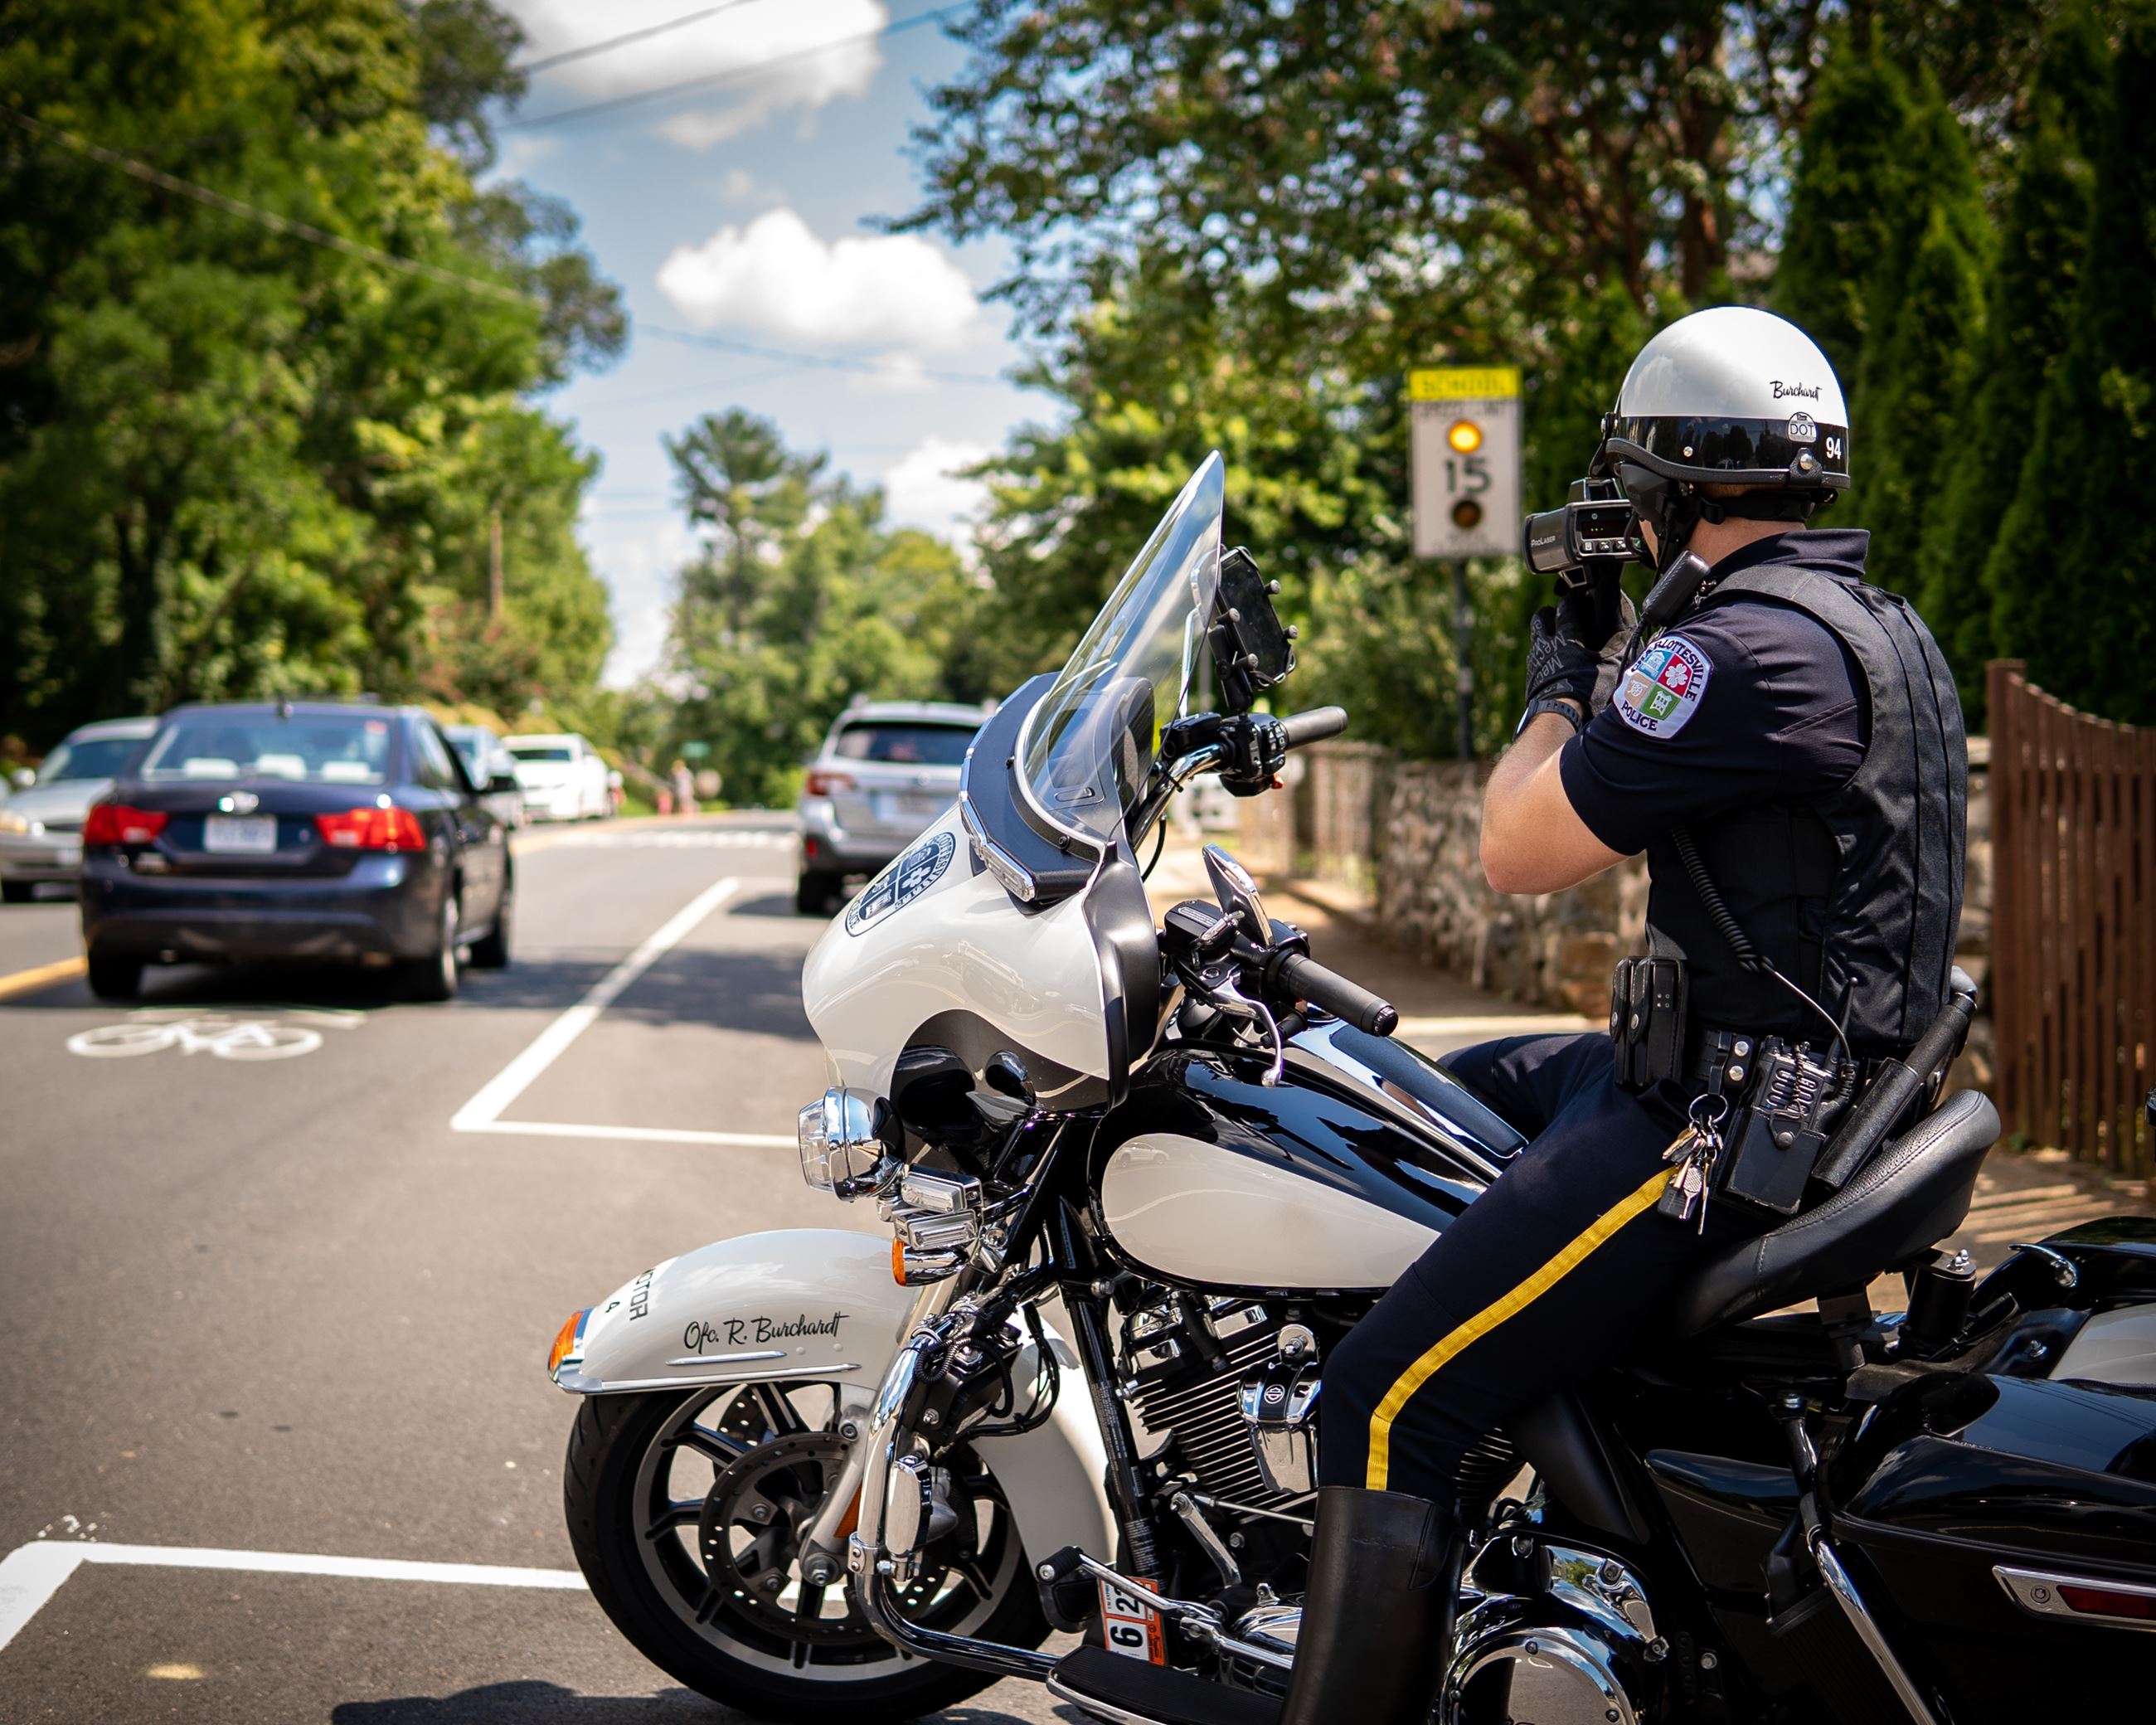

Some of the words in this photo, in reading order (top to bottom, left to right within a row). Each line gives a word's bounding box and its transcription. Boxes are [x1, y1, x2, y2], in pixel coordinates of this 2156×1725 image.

[1789, 424, 1814, 435] DOT
[1826, 437, 1842, 459] 94
[1445, 458, 1492, 494] 15
[1621, 700, 1658, 731] POLICE
[630, 1269, 655, 1320] OTOR
[683, 1321, 719, 1354] Ofc.
[723, 1317, 747, 1345] R.
[750, 1310, 850, 1344] Burchardt
[1114, 1586, 1140, 1615] 2
[1110, 1626, 1144, 1648] 6
